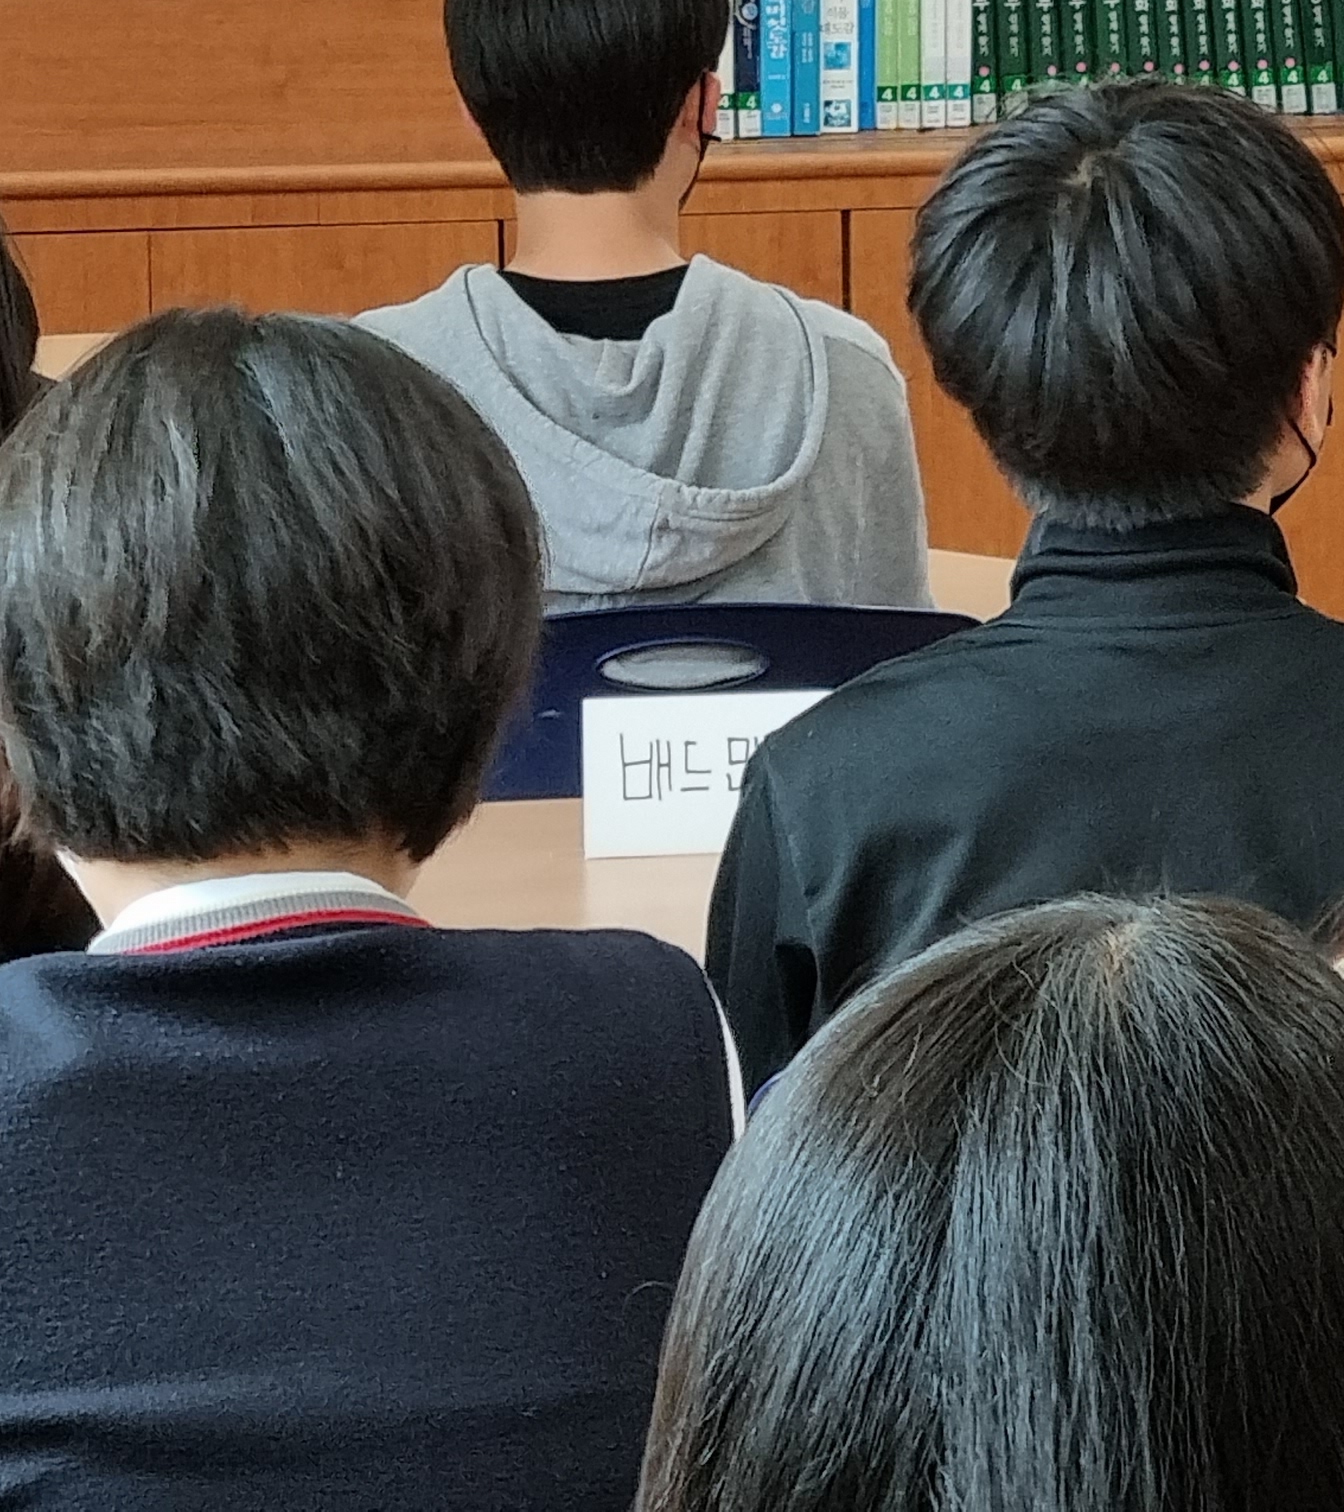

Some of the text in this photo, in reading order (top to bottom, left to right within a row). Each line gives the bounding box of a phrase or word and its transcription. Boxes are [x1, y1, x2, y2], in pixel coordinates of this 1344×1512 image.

[1227, 72, 1240, 87] 4
[1258, 71, 1271, 85] 4
[1287, 69, 1299, 84] 4
[1316, 68, 1330, 84] 4
[881, 87, 894, 101] 4
[906, 86, 918, 100] 4
[928, 86, 941, 99] 4
[952, 86, 965, 99] 4
